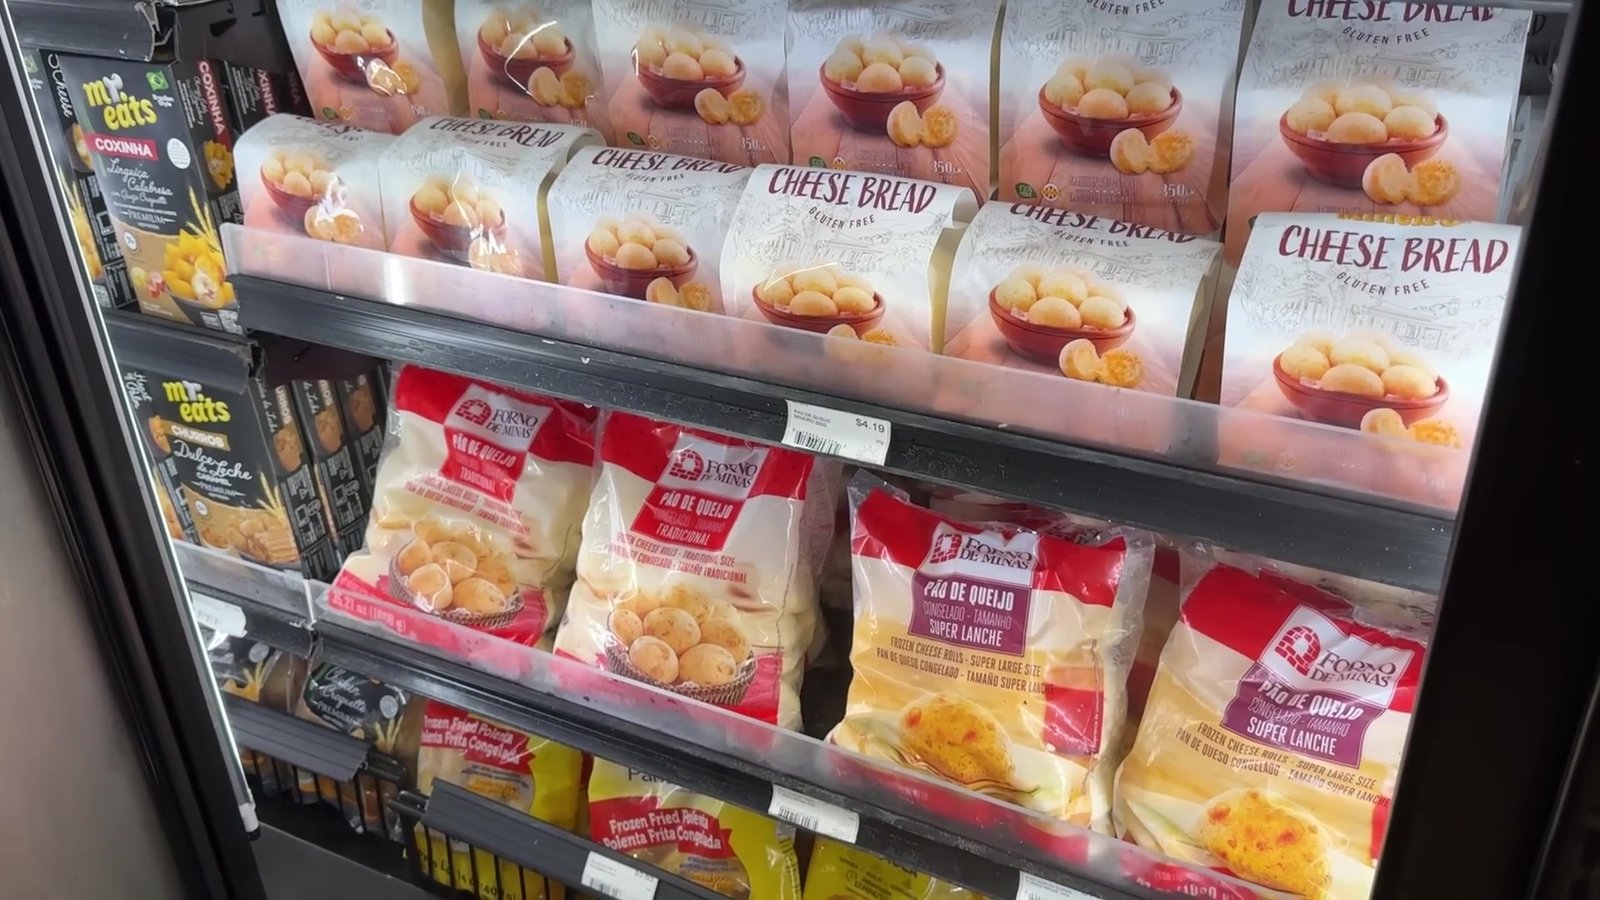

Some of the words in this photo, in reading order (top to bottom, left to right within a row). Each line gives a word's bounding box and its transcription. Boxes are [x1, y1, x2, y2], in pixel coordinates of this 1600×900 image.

[1288, 0, 1391, 22] CHEESE
[1342, 26, 1389, 45] GLUTEN
[1397, 27, 1430, 44] FREE
[199, 61, 226, 135] COXINHA
[103, 94, 158, 131] eats
[429, 117, 503, 136] CHEESE
[94, 137, 153, 158] COXINHA
[591, 148, 671, 173] CHEESE
[658, 173, 686, 183] FREE
[768, 167, 858, 207] CHEESE
[857, 176, 937, 214] BREAD
[808, 206, 845, 229] GLUTEN
[849, 213, 876, 229] FREE
[1010, 203, 1100, 230] CHEESE
[1053, 229, 1094, 245] GLUTEN
[1099, 238, 1130, 248] FREE
[1278, 225, 1395, 270] CHEESE
[1400, 236, 1509, 274] BREAD
[1336, 271, 1387, 295] GLUTEN
[1394, 278, 1430, 295] FREE
[180, 397, 231, 423] eats
[492, 408, 539, 427] FORNO
[171, 424, 225, 448] CHURROS
[485, 420, 502, 434] DE
[502, 424, 533, 439] MINAS
[855, 417, 885, 433] $4.19
[173, 439, 216, 465] Dulce
[480, 444, 517, 468] QUEIJO
[209, 460, 252, 480] Leche
[705, 458, 758, 477] FORNO
[713, 472, 753, 489] MINAS
[659, 490, 678, 508] PÃO
[680, 494, 695, 512] DE
[696, 498, 734, 520] QUEIJO
[656, 523, 711, 547] TRADICIONAL
[635, 537, 659, 554] CHEESE
[720, 555, 736, 568] SIZE
[959, 548, 979, 562] DE
[980, 553, 1030, 570] MINAS
[703, 566, 748, 585] TRADICIONAL
[923, 579, 948, 599] PÃO
[950, 583, 965, 601] DE
[969, 587, 1014, 612] QUEIJO
[922, 600, 965, 622] CONGELADO
[973, 609, 1012, 631] TAMANHO
[929, 618, 958, 640] SUPER
[961, 623, 1004, 648] LANCHE
[890, 636, 914, 653] FROZEN
[916, 641, 943, 660] CHEESE
[943, 648, 964, 665] ROLLS
[970, 654, 996, 670] SUPER
[997, 659, 1023, 675] LARGE
[1024, 663, 1041, 678] SIZE
[1317, 649, 1397, 676] FORNO
[876, 647, 889, 660] PAN
[889, 651, 899, 663] DE
[899, 654, 919, 670] QUESO
[920, 659, 960, 680] CONGELADO
[966, 667, 999, 689] TAMAÑO
[1000, 676, 1027, 694] SUPER
[1028, 680, 1056, 697] LANCHE
[1310, 667, 1332, 683] DE
[1333, 670, 1392, 689] MINAS
[1257, 679, 1284, 705] PÃO
[1288, 692, 1308, 710] DE
[1308, 694, 1365, 722] QUEIJO
[1247, 696, 1303, 727] CONGELADO
[1305, 716, 1351, 738] TAMANHO
[478, 722, 514, 745] Polenta
[1246, 715, 1287, 746] SUPER
[1290, 729, 1338, 757] LANCHE
[444, 731, 467, 748] Frita
[468, 736, 521, 765] Congelada
[1197, 721, 1226, 747] FROZEN
[1227, 735, 1260, 757] CHEESE
[1261, 749, 1289, 765] ROLLS
[1296, 759, 1327, 777] SUPER
[1326, 767, 1356, 785] LARGE
[1356, 773, 1377, 792] SIZE
[1175, 727, 1190, 747] PAN
[1190, 735, 1201, 752] DE
[1201, 743, 1229, 766] QUESO
[1230, 755, 1280, 777] CONGELADO
[1288, 768, 1326, 790] TAMAÑO
[1325, 779, 1355, 798] SUPER
[1354, 788, 1391, 808] LANCHE
[608, 815, 648, 835] Frozen
[649, 810, 680, 827] Fried
[682, 808, 709, 830] Polenta
[602, 831, 648, 851] Polenta
[649, 828, 677, 844] Frita
